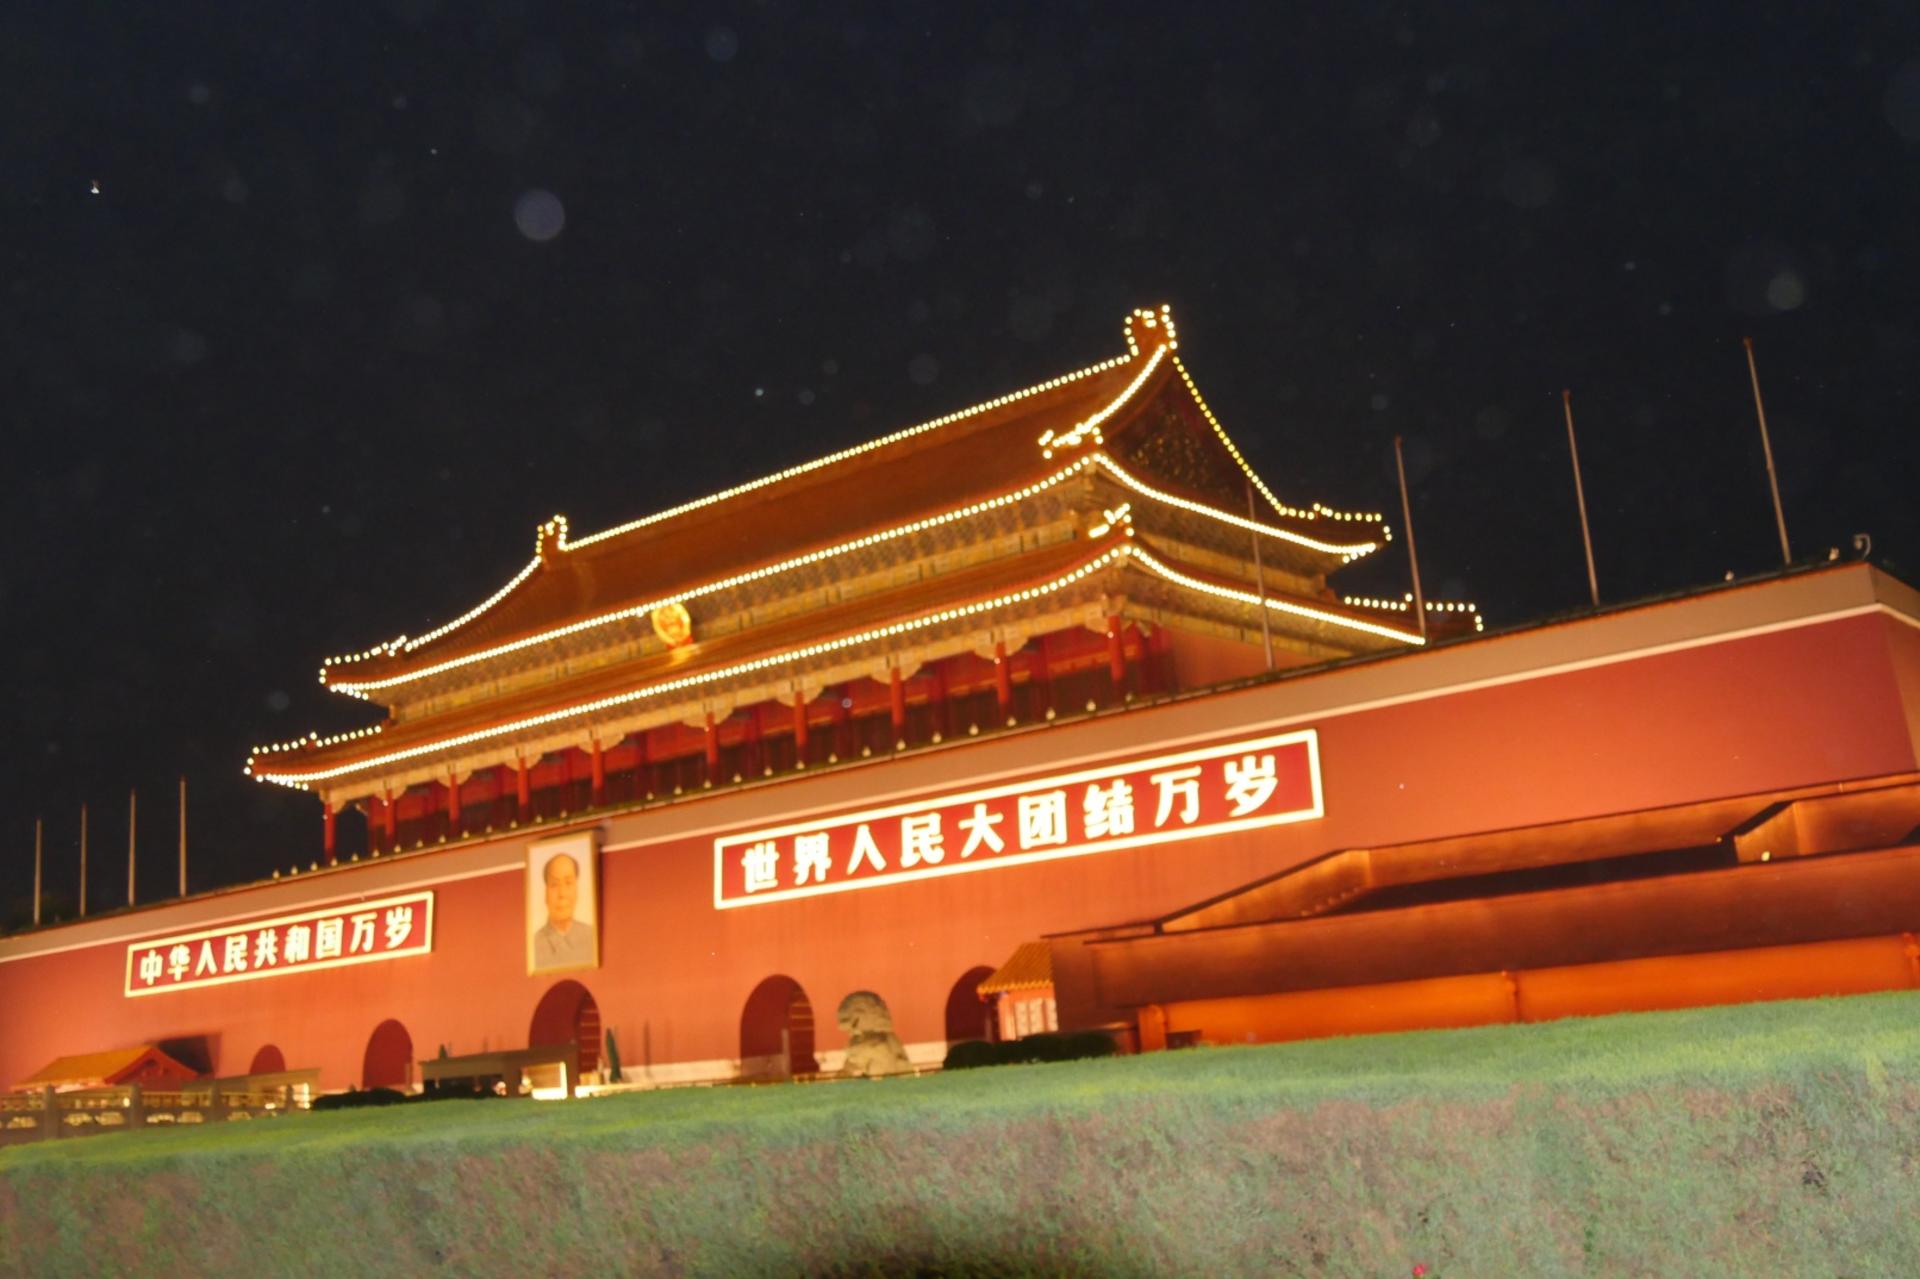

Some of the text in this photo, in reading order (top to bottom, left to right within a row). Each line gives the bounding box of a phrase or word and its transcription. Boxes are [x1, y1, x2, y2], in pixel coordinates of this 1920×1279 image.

[740, 754, 1278, 894] 世界人民大团结万岁
[139, 906, 413, 985] 中华人民共和国万岁
